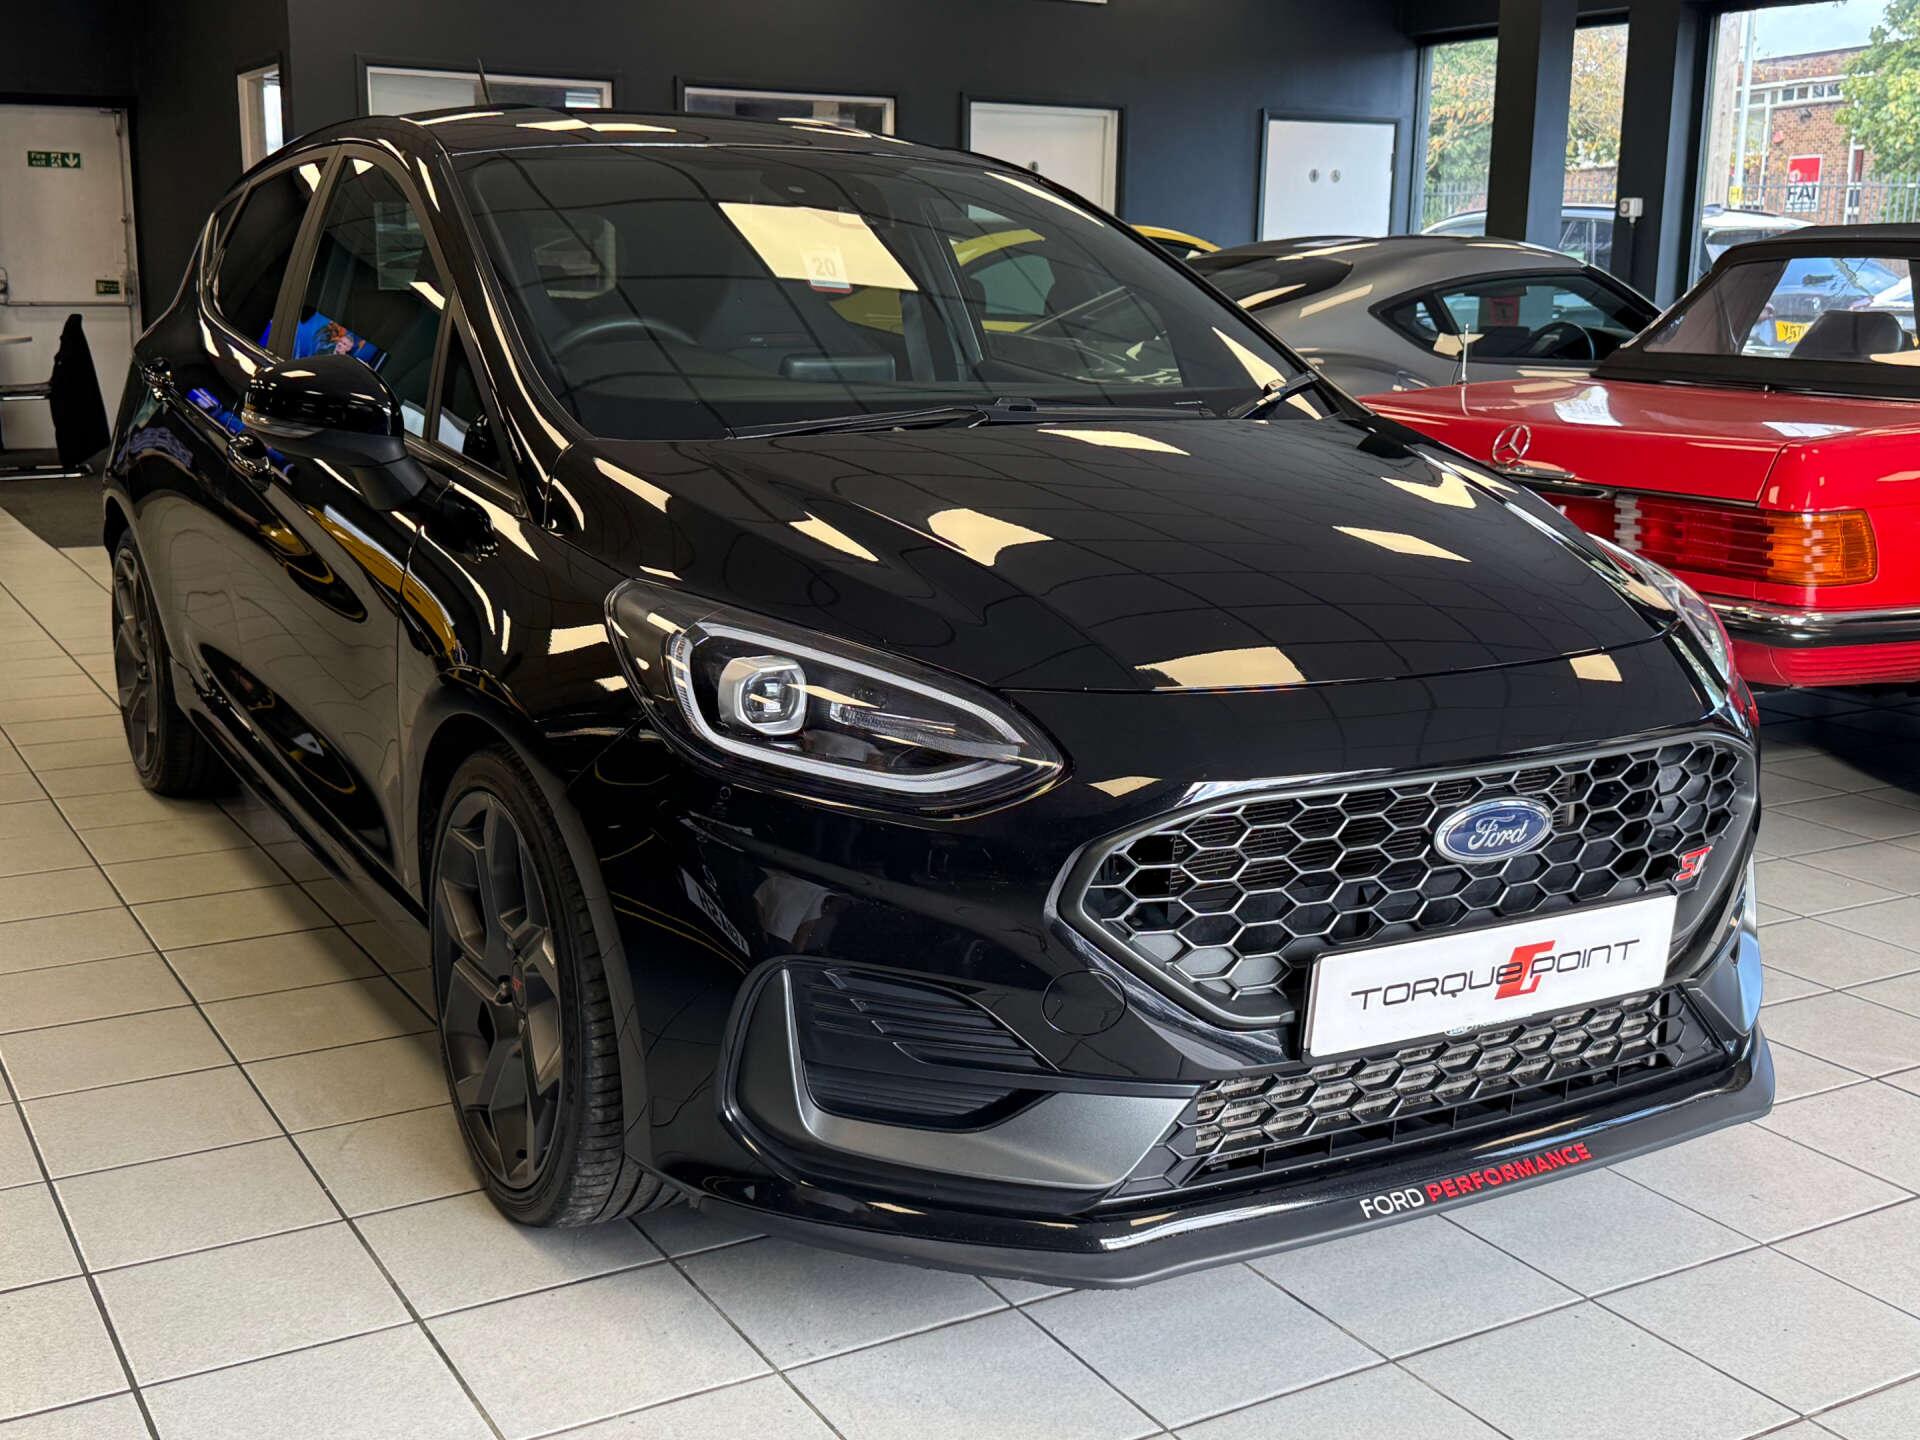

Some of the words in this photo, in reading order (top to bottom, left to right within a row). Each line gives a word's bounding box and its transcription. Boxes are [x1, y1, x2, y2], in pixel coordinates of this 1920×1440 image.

[811, 257, 837, 278] 20
[1467, 814, 1530, 850] Ford
[1674, 845, 1713, 882] ST
[1359, 1188, 1425, 1219] FORD
[1424, 1142, 1593, 1204] PERFORMANCE
